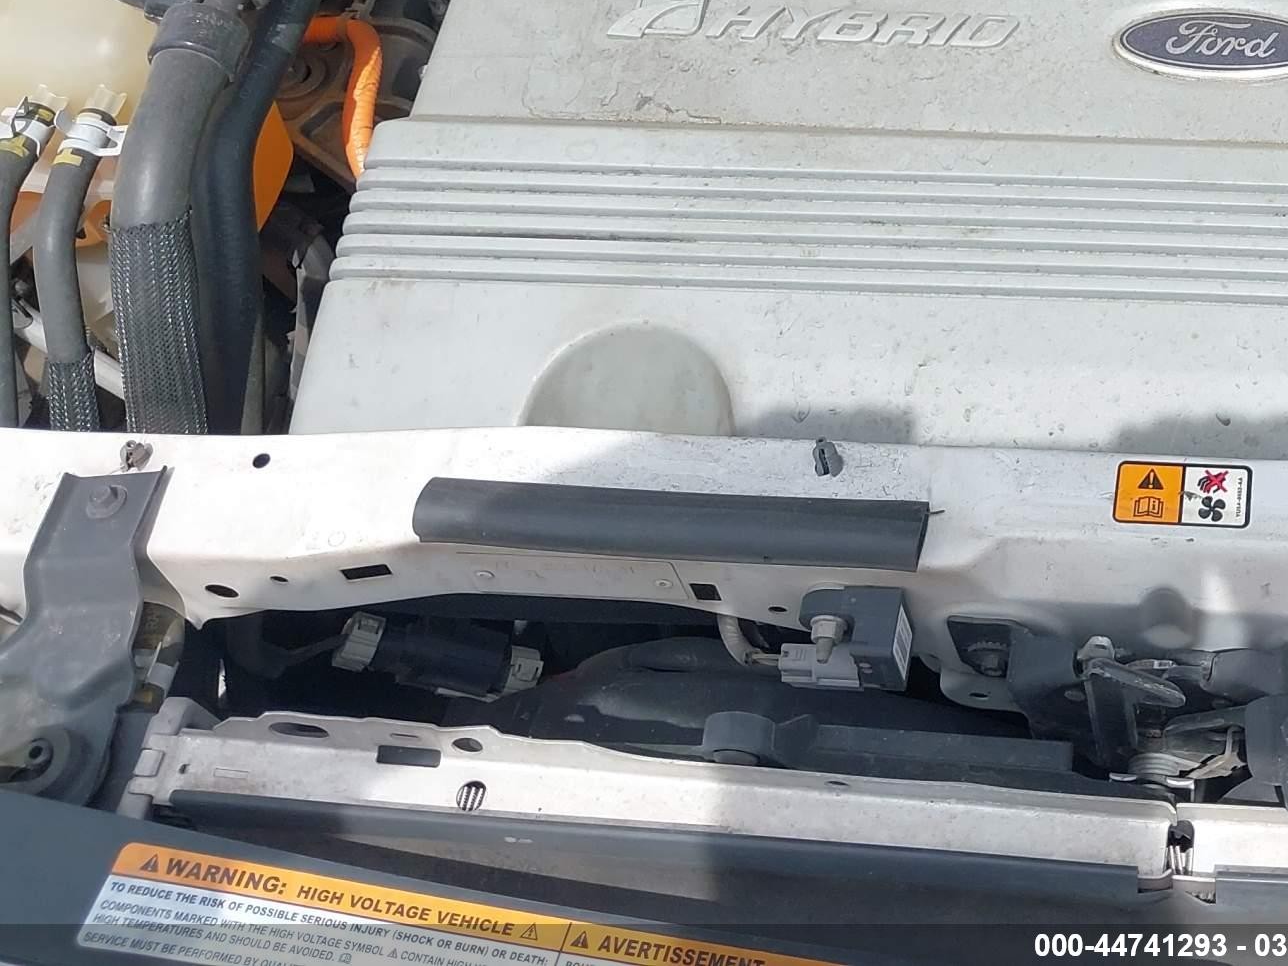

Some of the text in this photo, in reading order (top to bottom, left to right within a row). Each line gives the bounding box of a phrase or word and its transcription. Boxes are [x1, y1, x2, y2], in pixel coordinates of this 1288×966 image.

[706, 6, 1020, 48] HYBRID
[1166, 20, 1279, 58] Ford
[166, 858, 515, 936] WARNING: HIGH VOLTAGE VEHICLE
[84, 931, 130, 947] SERVICE
[130, 938, 160, 952] MUST
[160, 944, 176, 954] BE
[178, 946, 242, 965] PERFORMED
[93, 913, 120, 926] HIGH
[122, 917, 202, 939] TEMPERATURES
[203, 932, 228, 943] AND
[228, 936, 271, 950] SHOULD
[272, 942, 288, 952] BE
[288, 944, 335, 962] AVOIDED.
[100, 900, 174, 920] COMPONENTS
[174, 911, 218, 927] MARKED
[220, 919, 245, 932] WITH
[247, 924, 268, 935] THE
[269, 927, 294, 940] HIGH
[297, 932, 342, 949] VOLTAGE
[344, 940, 384, 956] SYMBOL
[400, 950, 445, 966] CONTAIN
[110, 882, 126, 892] TO
[127, 885, 174, 900] REDUCE
[176, 892, 198, 904] THE
[199, 896, 226, 908] RISK
[228, 901, 244, 911] OF
[245, 904, 300, 922] POSSIBLE
[300, 914, 348, 930] SERIOUS
[350, 923, 390, 938] INJURY
[392, 929, 438, 946] (SHOCK
[437, 938, 452, 949] OR
[454, 942, 488, 957] BURN)
[491, 948, 508, 960] OR
[510, 951, 549, 966] DEATH:
